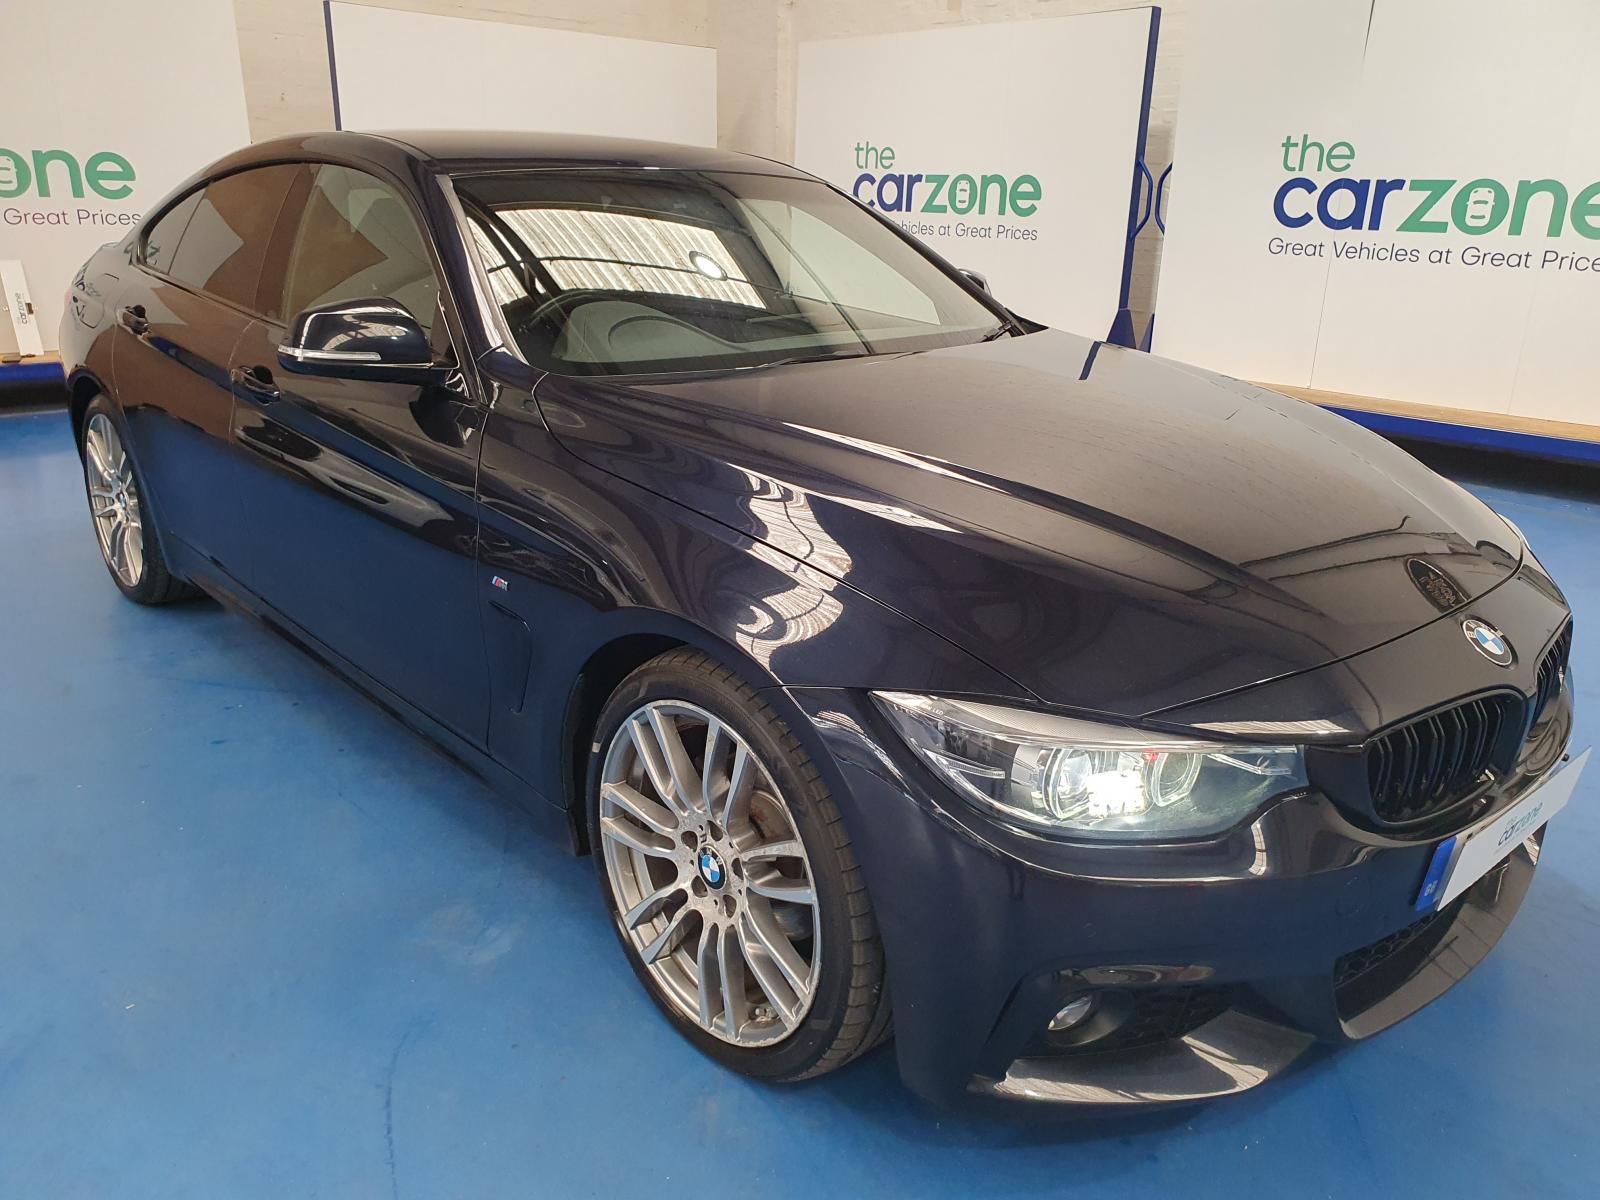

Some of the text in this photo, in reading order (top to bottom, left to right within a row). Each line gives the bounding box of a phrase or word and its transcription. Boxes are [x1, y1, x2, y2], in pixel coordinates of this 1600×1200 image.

[853, 141, 896, 169] the
[1281, 134, 1356, 173] the
[853, 173, 1042, 217] carzone
[1273, 177, 1600, 240] carzone
[3, 207, 142, 226] Great Prices
[902, 220, 1038, 241] hicles at Great Prices
[1268, 237, 1325, 258] Great
[1333, 241, 1421, 263] Vehicles
[1428, 248, 1453, 265] at
[1461, 246, 1533, 269] Great
